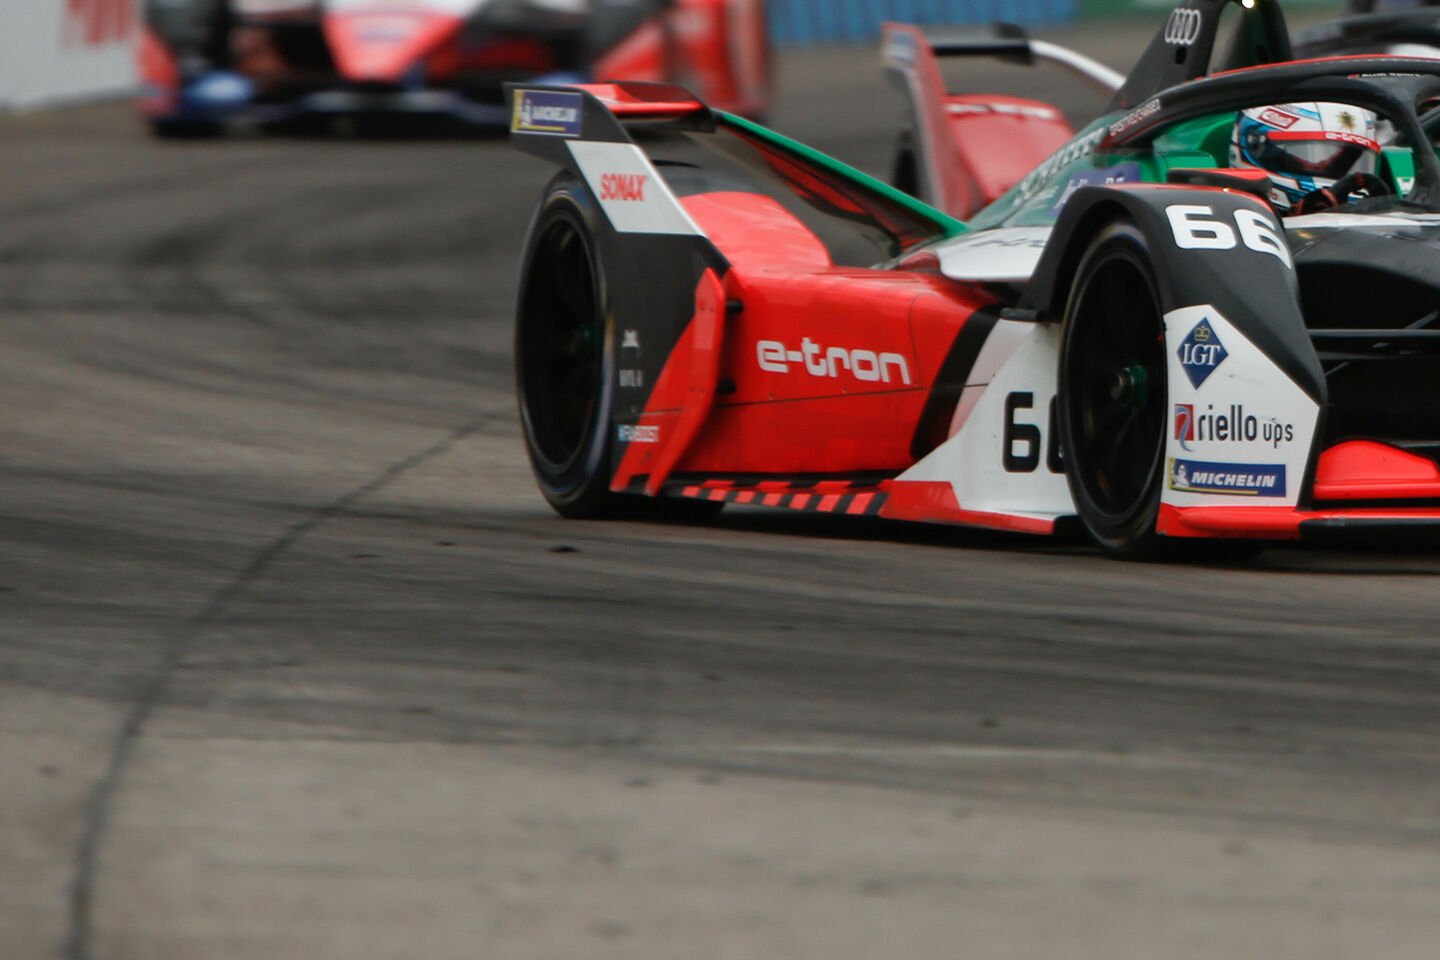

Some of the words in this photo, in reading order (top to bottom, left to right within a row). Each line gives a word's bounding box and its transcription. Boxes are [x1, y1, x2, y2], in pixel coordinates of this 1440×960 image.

[1325, 131, 1371, 146] e-tron
[600, 173, 647, 201] SONAX
[1165, 204, 1292, 269] 66
[756, 336, 911, 385] e-tron
[1182, 343, 1221, 366] LGT
[1198, 404, 1258, 442] riello
[1263, 423, 1293, 449] ups
[1190, 471, 1276, 488] MICHELIN
